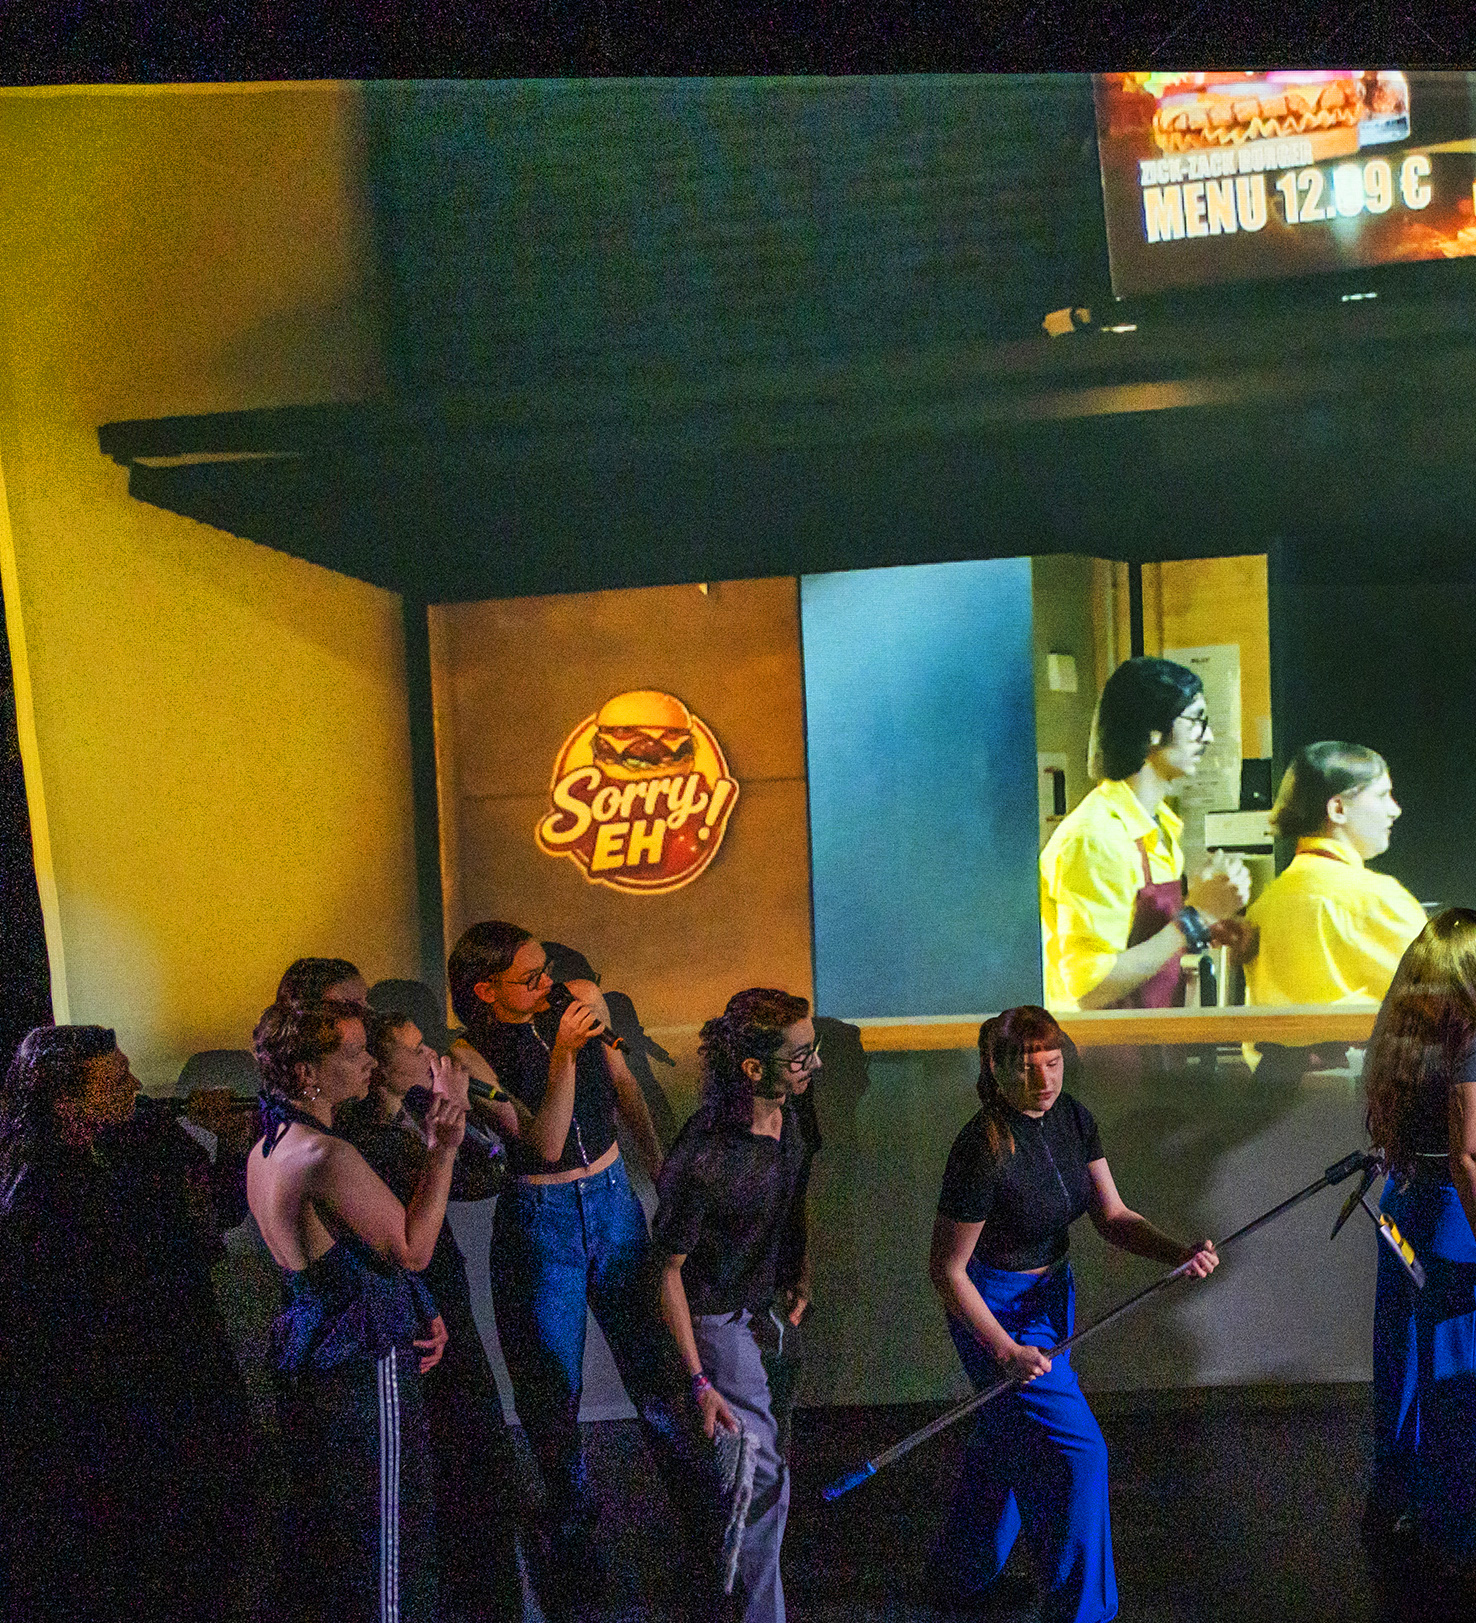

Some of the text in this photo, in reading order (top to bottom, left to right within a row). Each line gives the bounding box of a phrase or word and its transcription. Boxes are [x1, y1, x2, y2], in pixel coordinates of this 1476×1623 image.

[1143, 154, 1433, 244] MENU 12.9 €
[541, 766, 732, 844] Sorry!
[591, 818, 667, 872] EH
